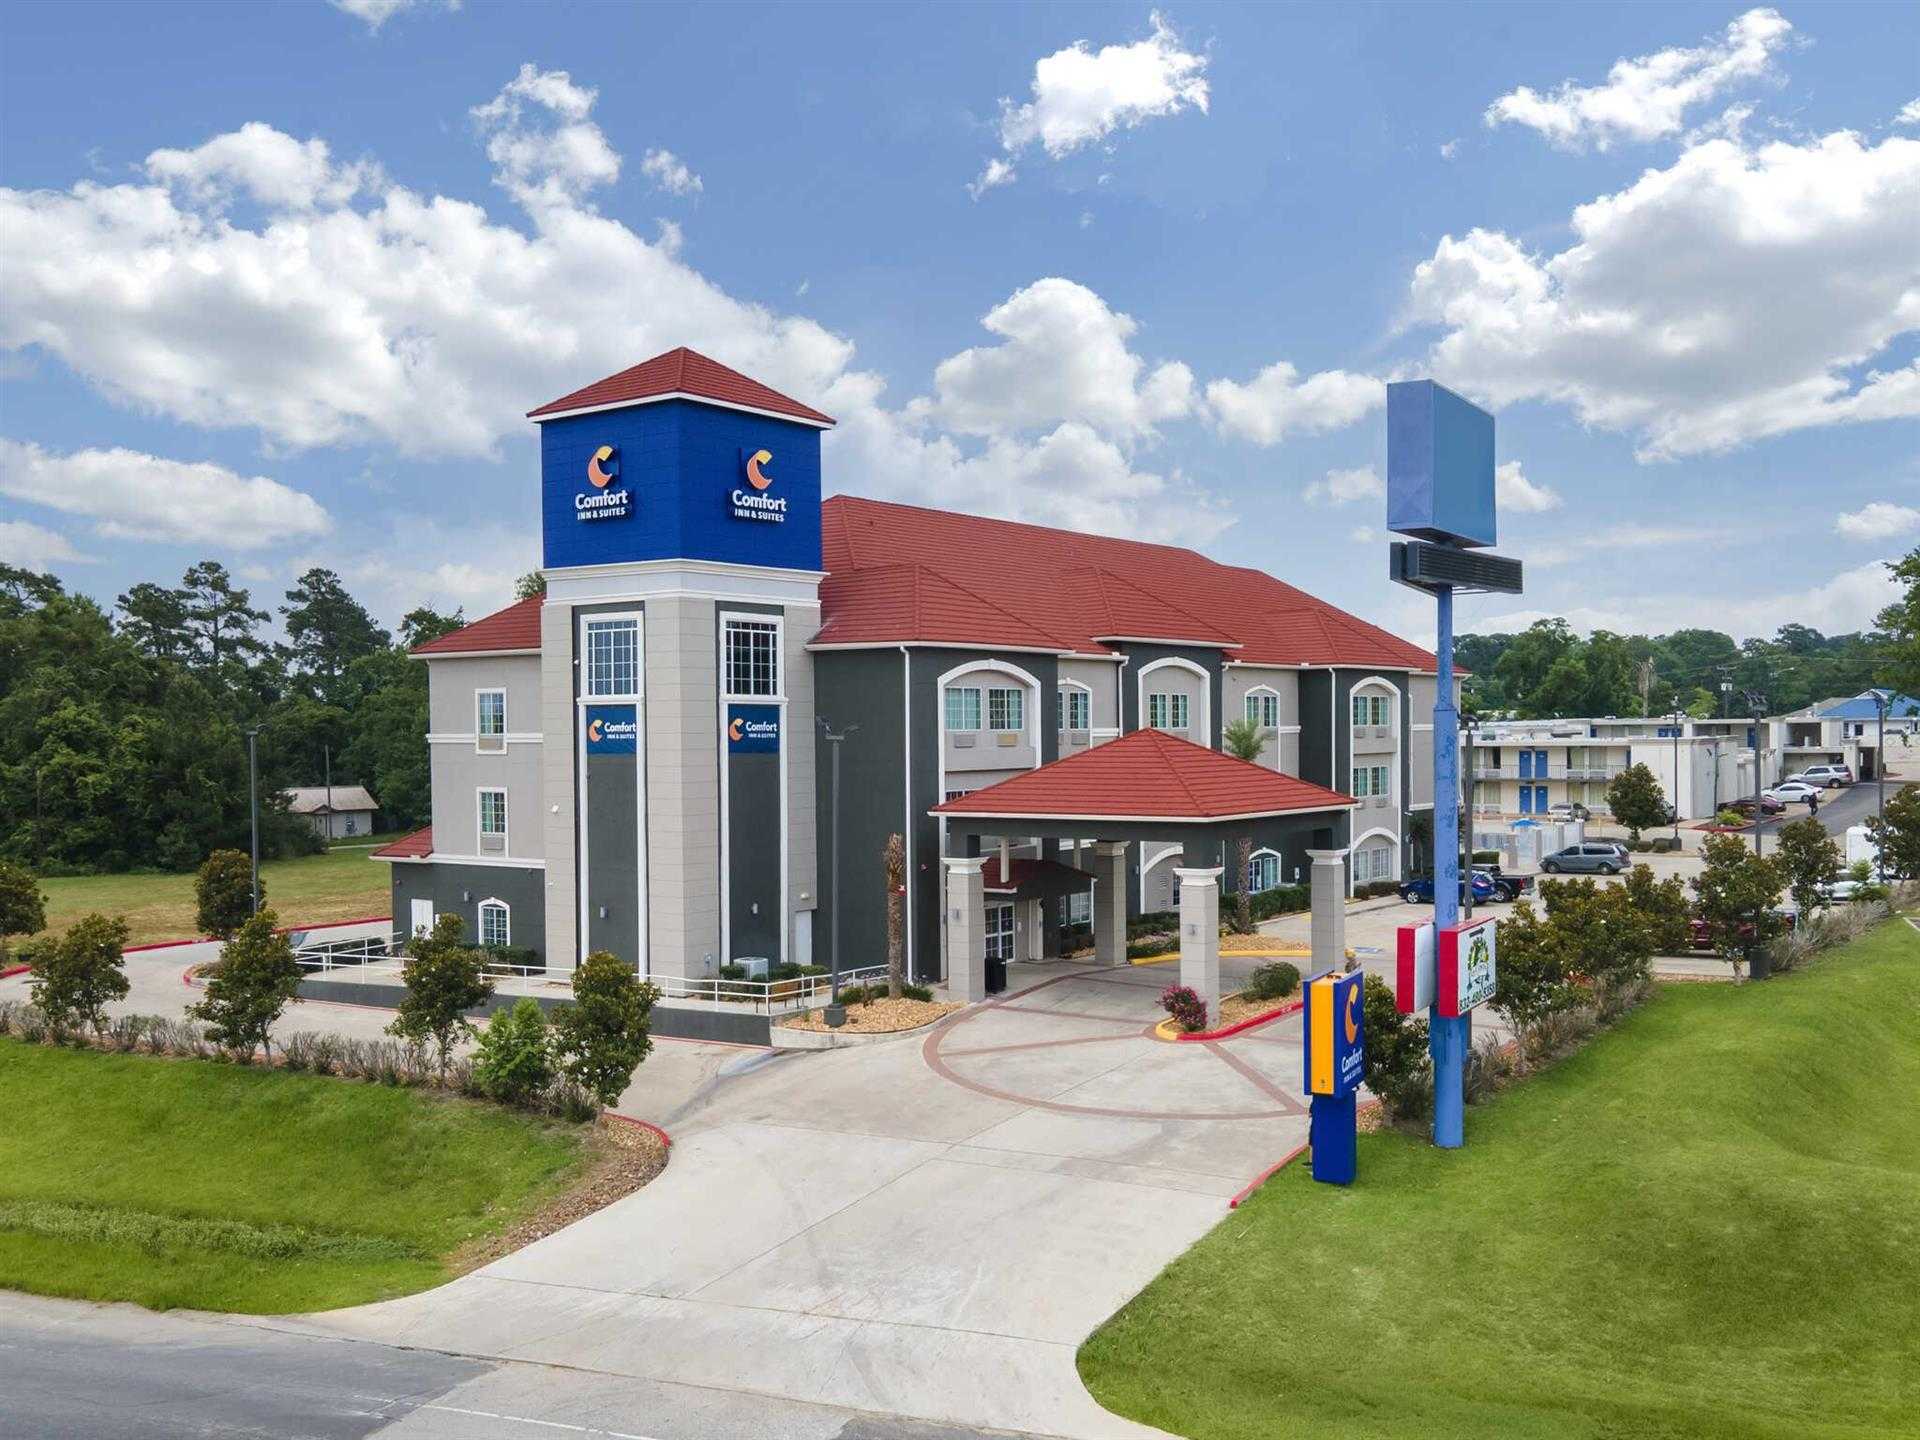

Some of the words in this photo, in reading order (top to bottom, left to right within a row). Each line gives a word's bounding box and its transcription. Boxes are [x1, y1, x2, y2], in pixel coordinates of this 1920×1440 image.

[575, 490, 628, 510] Comfort
[732, 489, 787, 512] Comfort
[577, 511, 592, 521] INN
[592, 510, 598, 519] &
[599, 507, 626, 518] SUITES
[734, 508, 750, 518] INN
[751, 510, 757, 519] &
[758, 511, 785, 523] SUITES
[604, 721, 636, 733] Comfort
[745, 721, 778, 732] Comfort
[1341, 1047, 1363, 1073] Comfort
